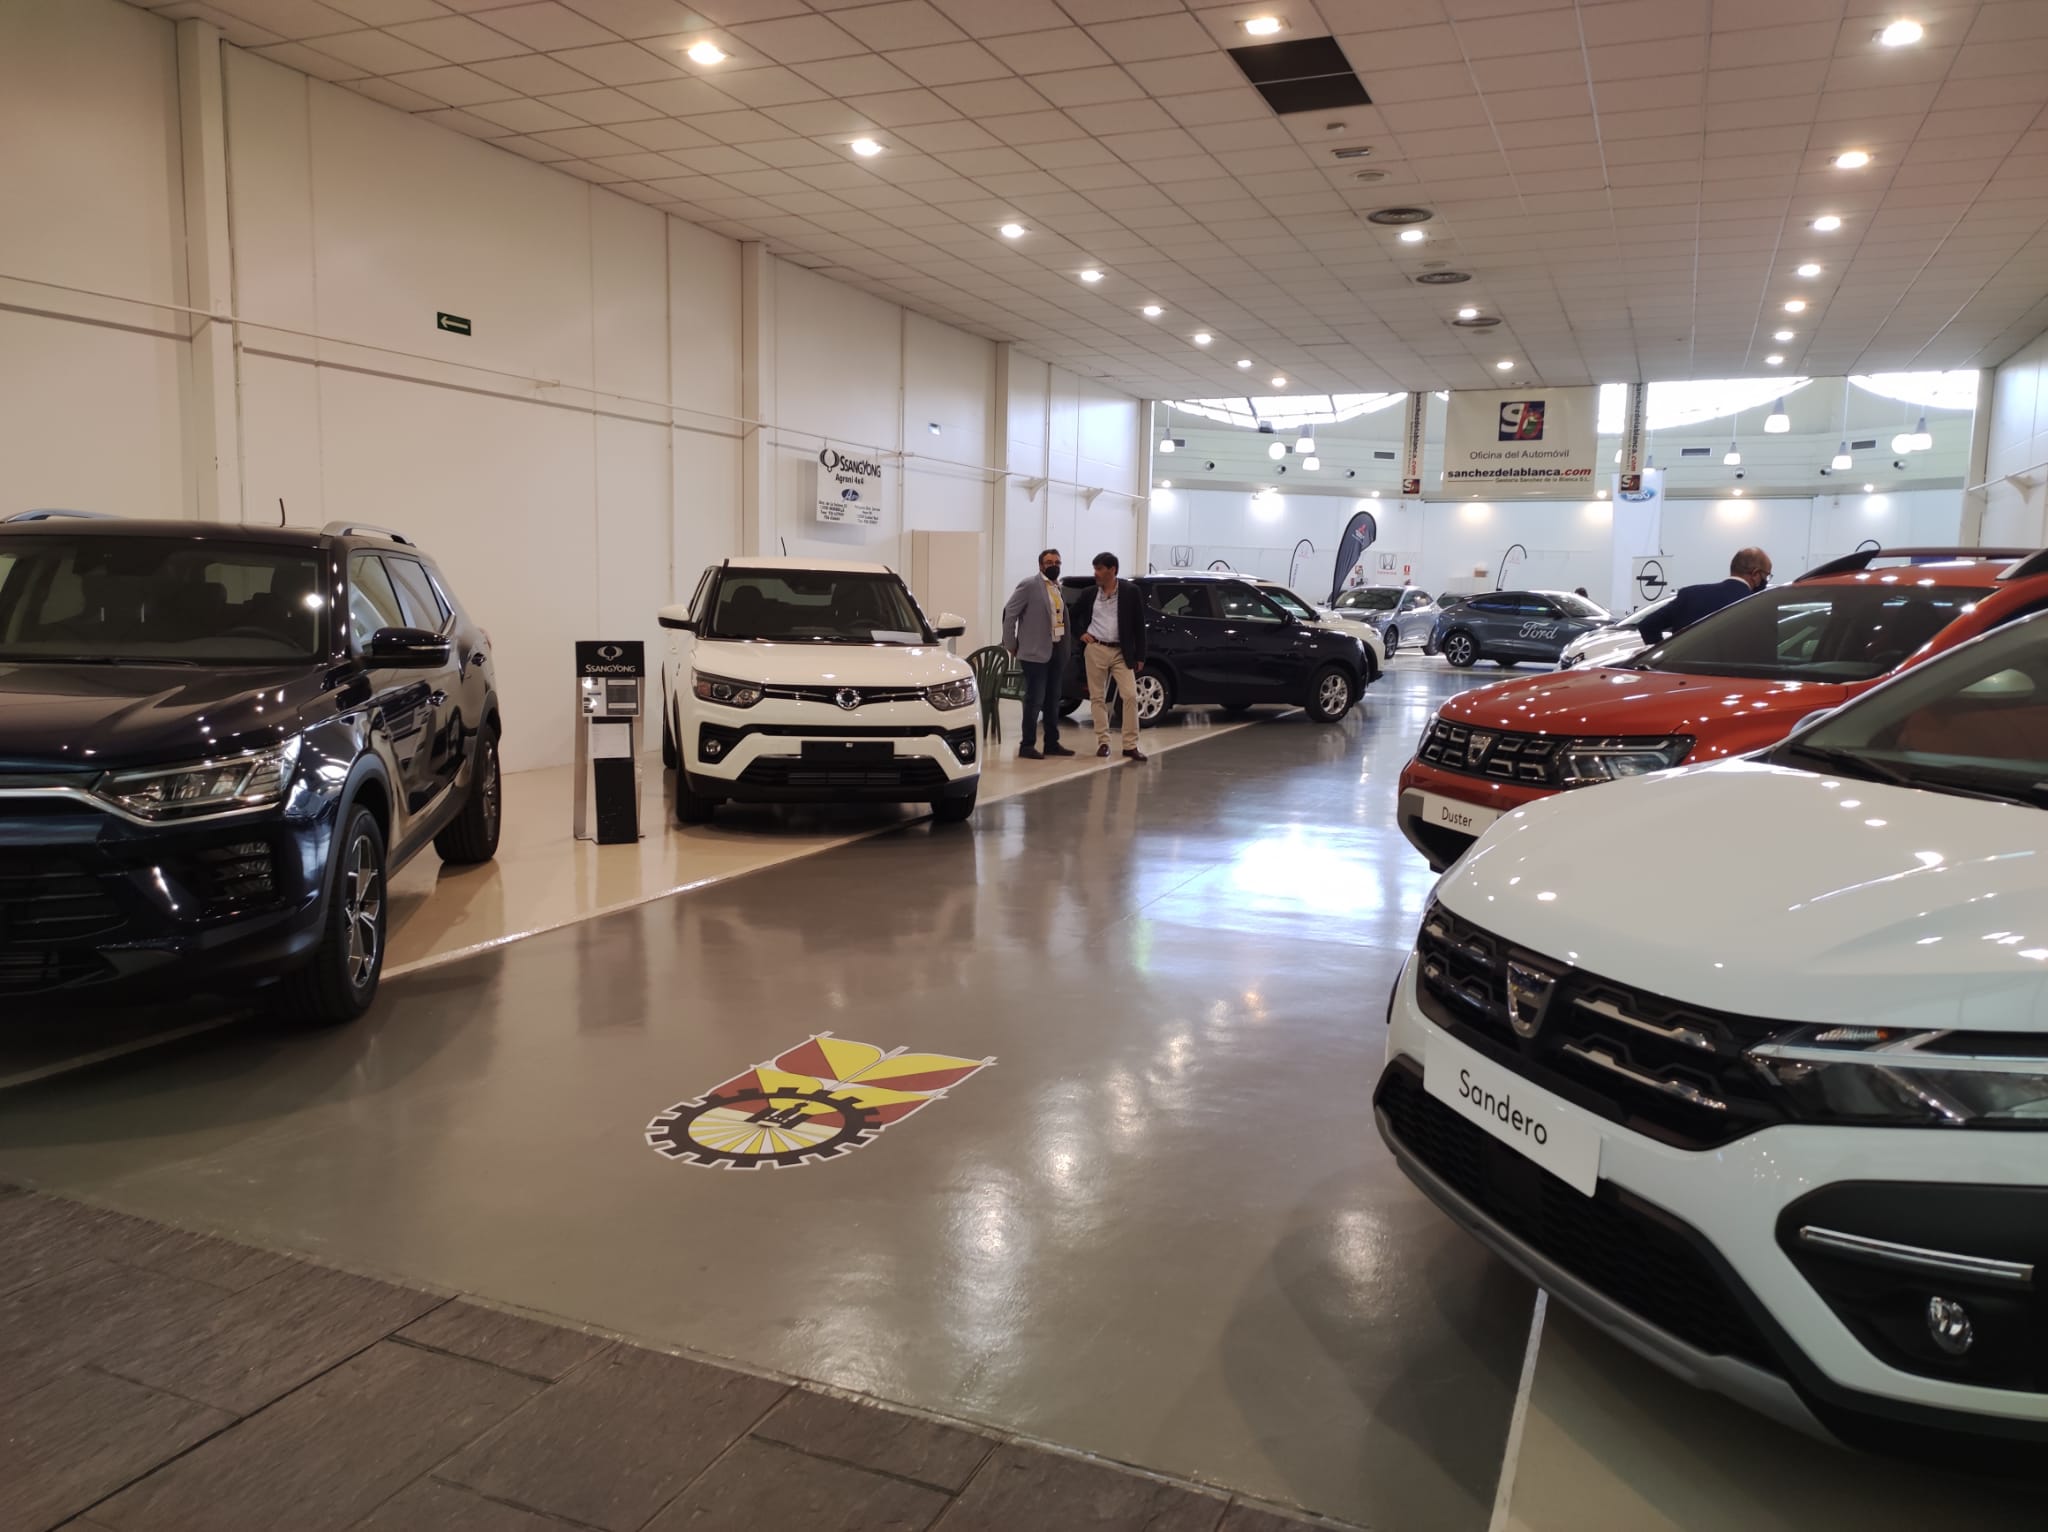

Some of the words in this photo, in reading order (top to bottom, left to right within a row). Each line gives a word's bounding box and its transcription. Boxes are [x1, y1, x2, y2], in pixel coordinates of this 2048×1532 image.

[1470, 451, 1502, 460] Oficina
[1505, 450, 1519, 459] del
[1521, 449, 1569, 459] Automóvil
[1448, 468, 1592, 478] sanchezdelablanca.com
[1519, 621, 1559, 640] Ford
[1441, 806, 1473, 827] Duster
[1458, 1069, 1547, 1145] Sandero
